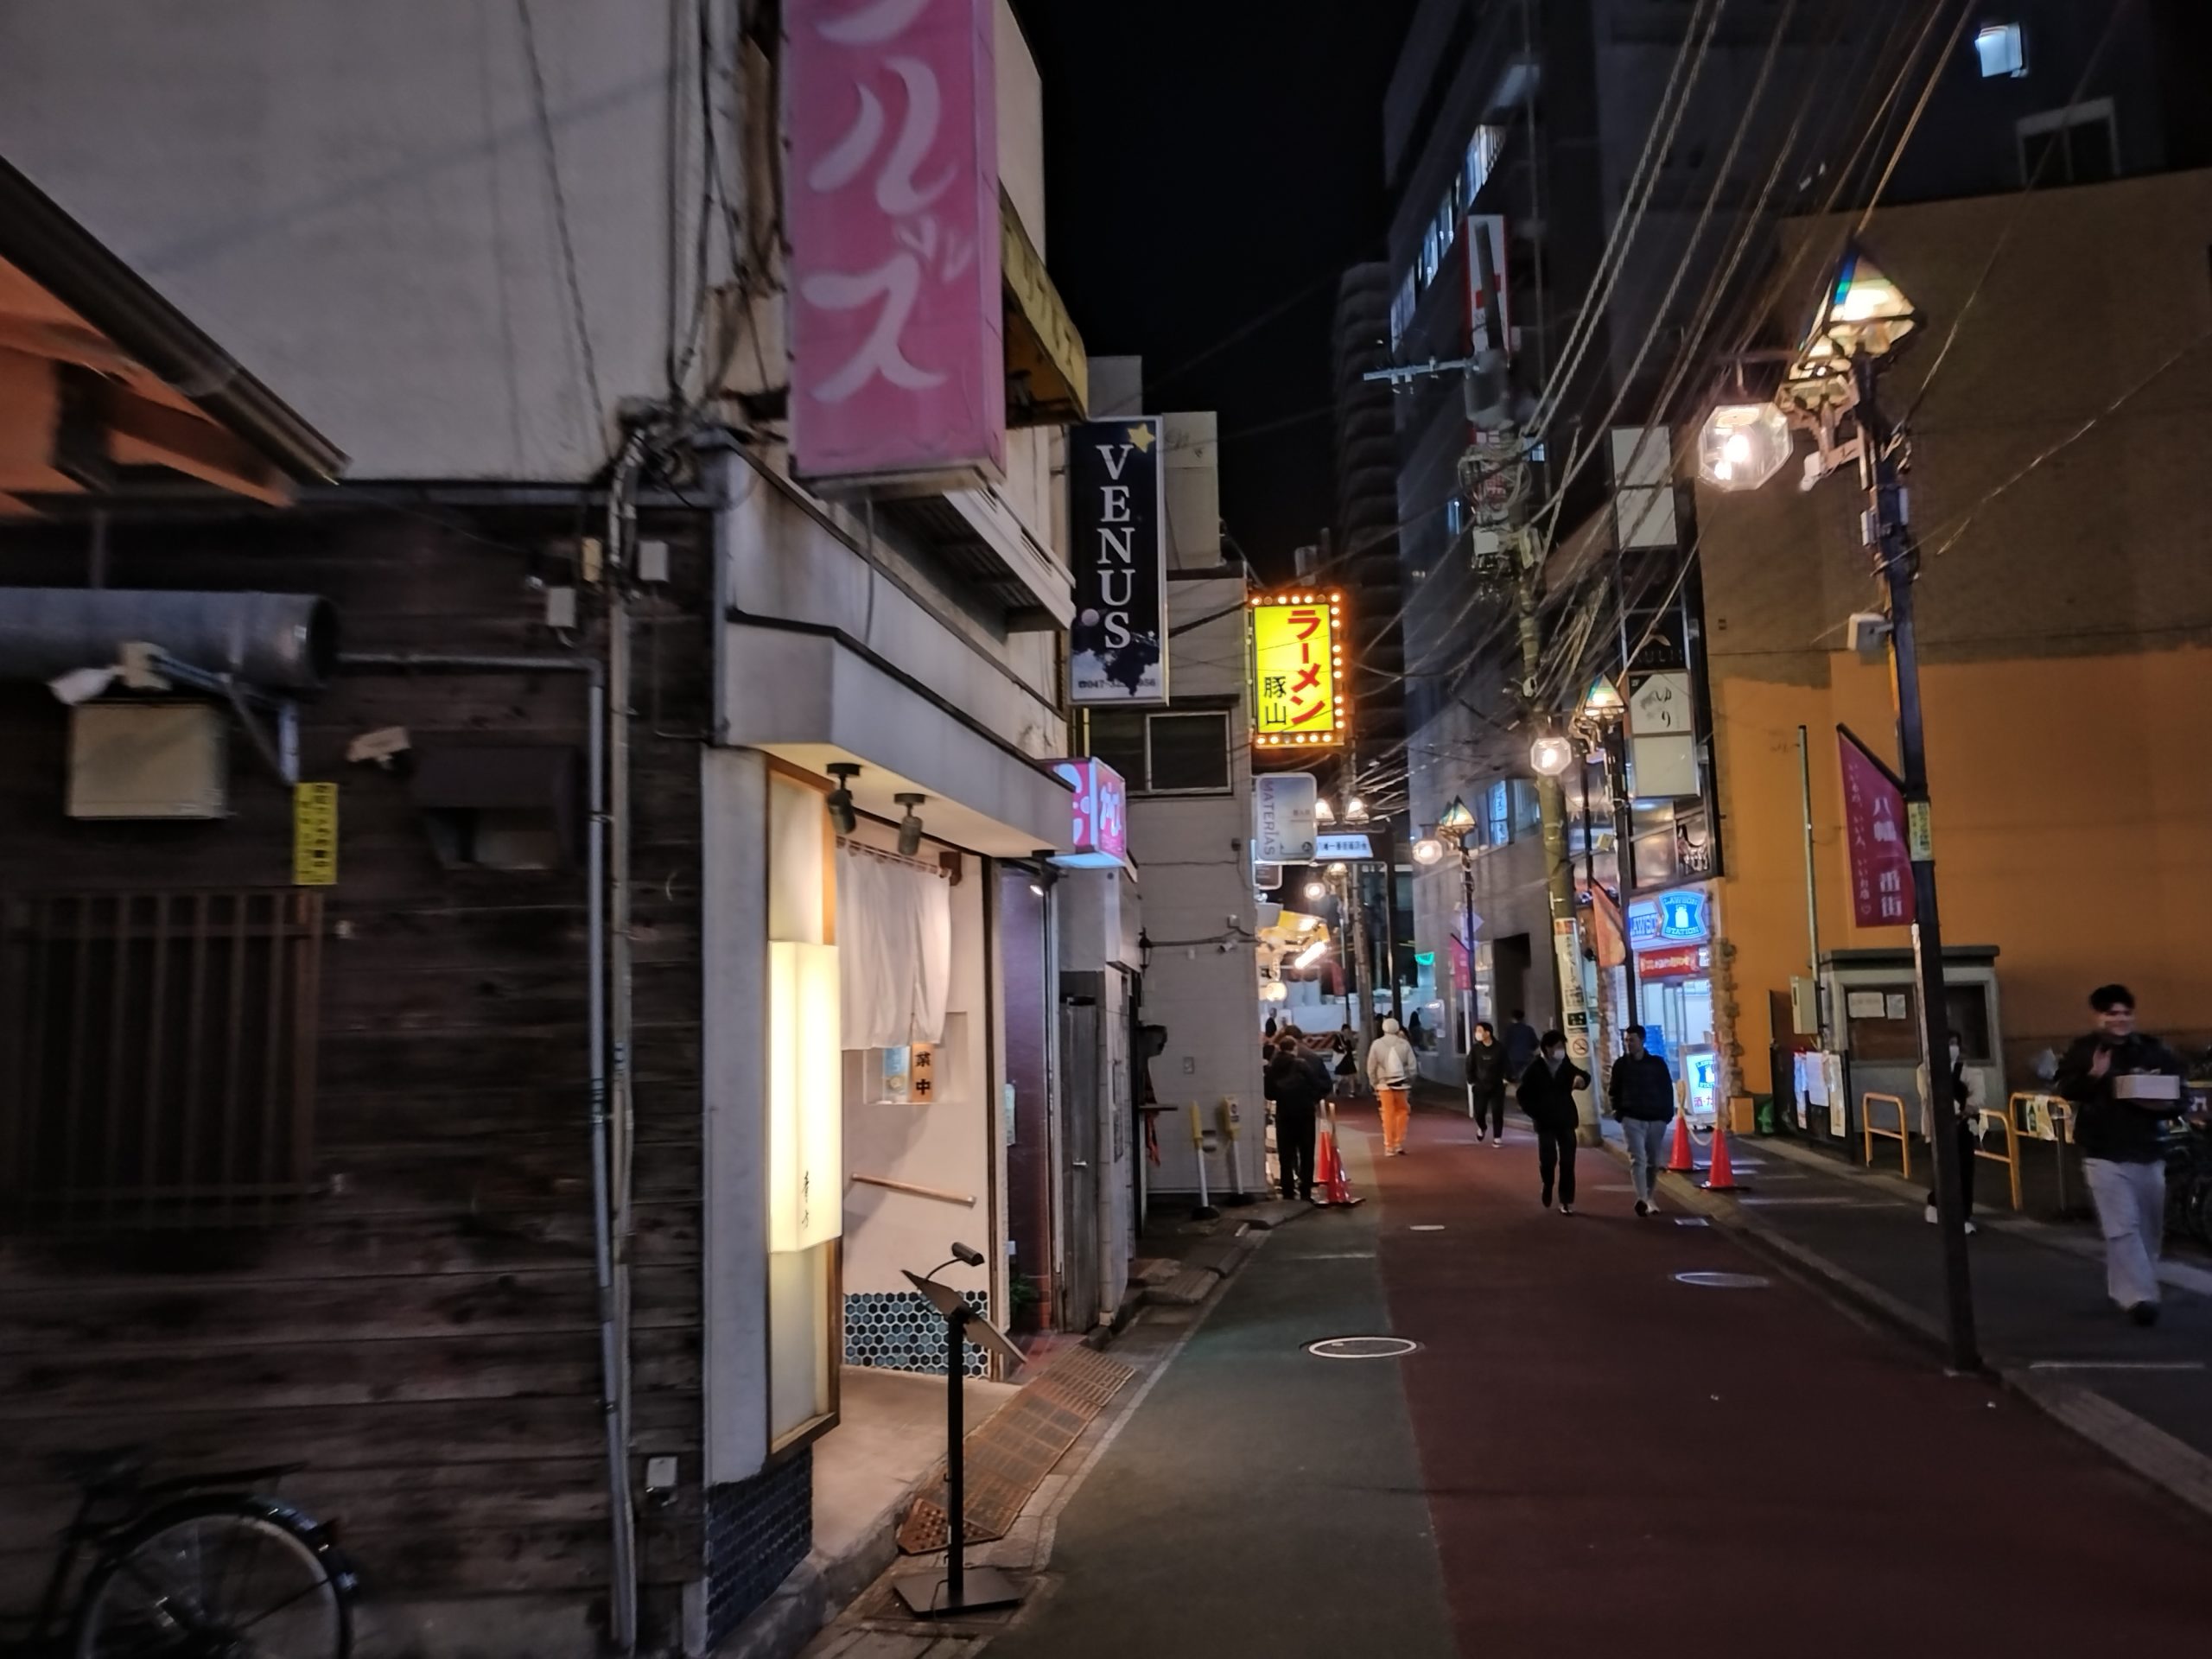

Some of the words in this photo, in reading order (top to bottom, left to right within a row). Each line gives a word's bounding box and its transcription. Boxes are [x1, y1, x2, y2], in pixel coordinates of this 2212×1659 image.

[1096, 444, 1136, 649] VENUS
[1264, 676, 1287, 726] 豚山
[1287, 609, 1325, 726] ラーメン
[1663, 896, 1699, 906] LAWSON
